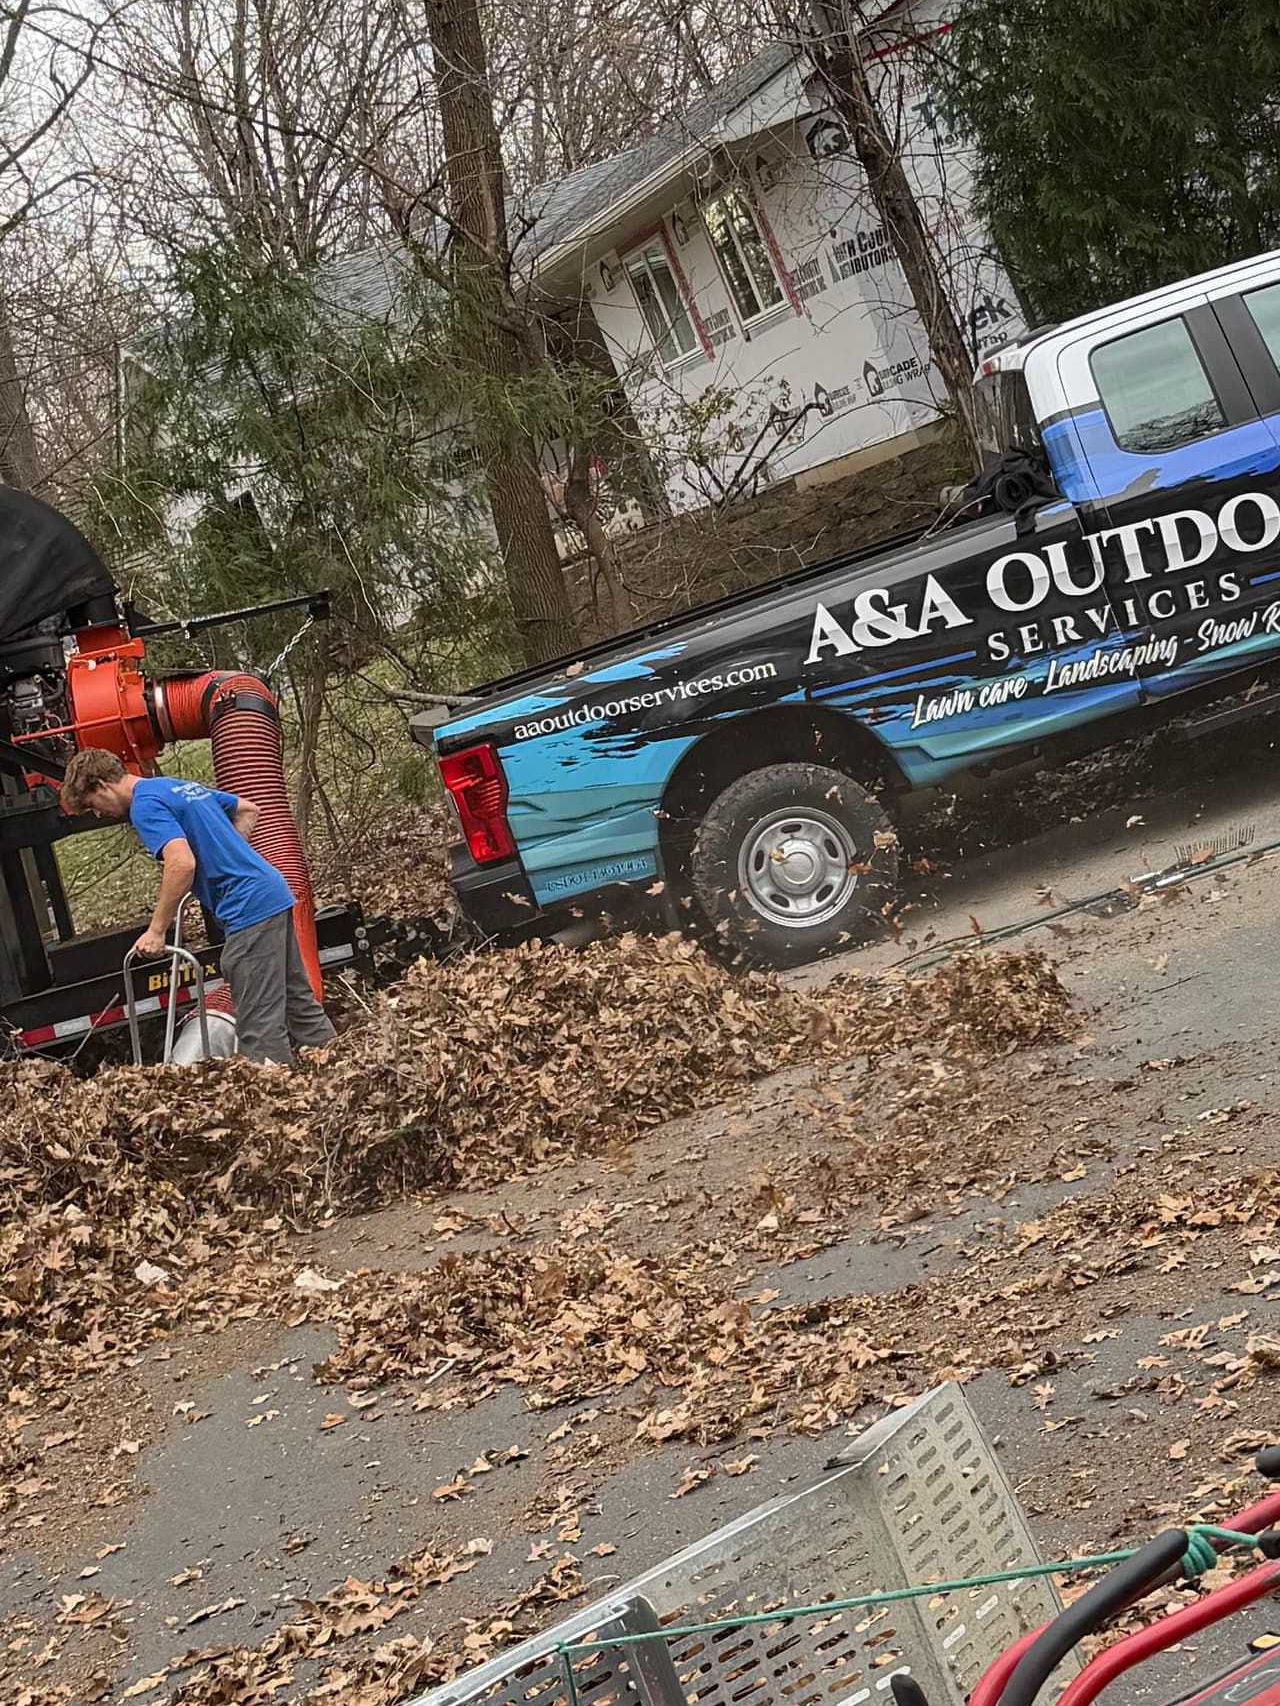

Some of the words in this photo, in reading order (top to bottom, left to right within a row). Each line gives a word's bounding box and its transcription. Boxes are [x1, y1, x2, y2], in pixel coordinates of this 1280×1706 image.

[803, 572, 973, 666] A&A
[987, 572, 1243, 662] SERVICES
[514, 660, 777, 741] aaoutdoorservices.com
[910, 692, 974, 730] Lawn
[979, 676, 1028, 709] care
[1043, 633, 1180, 693] Landscaping
[1196, 618, 1258, 652] Snow
